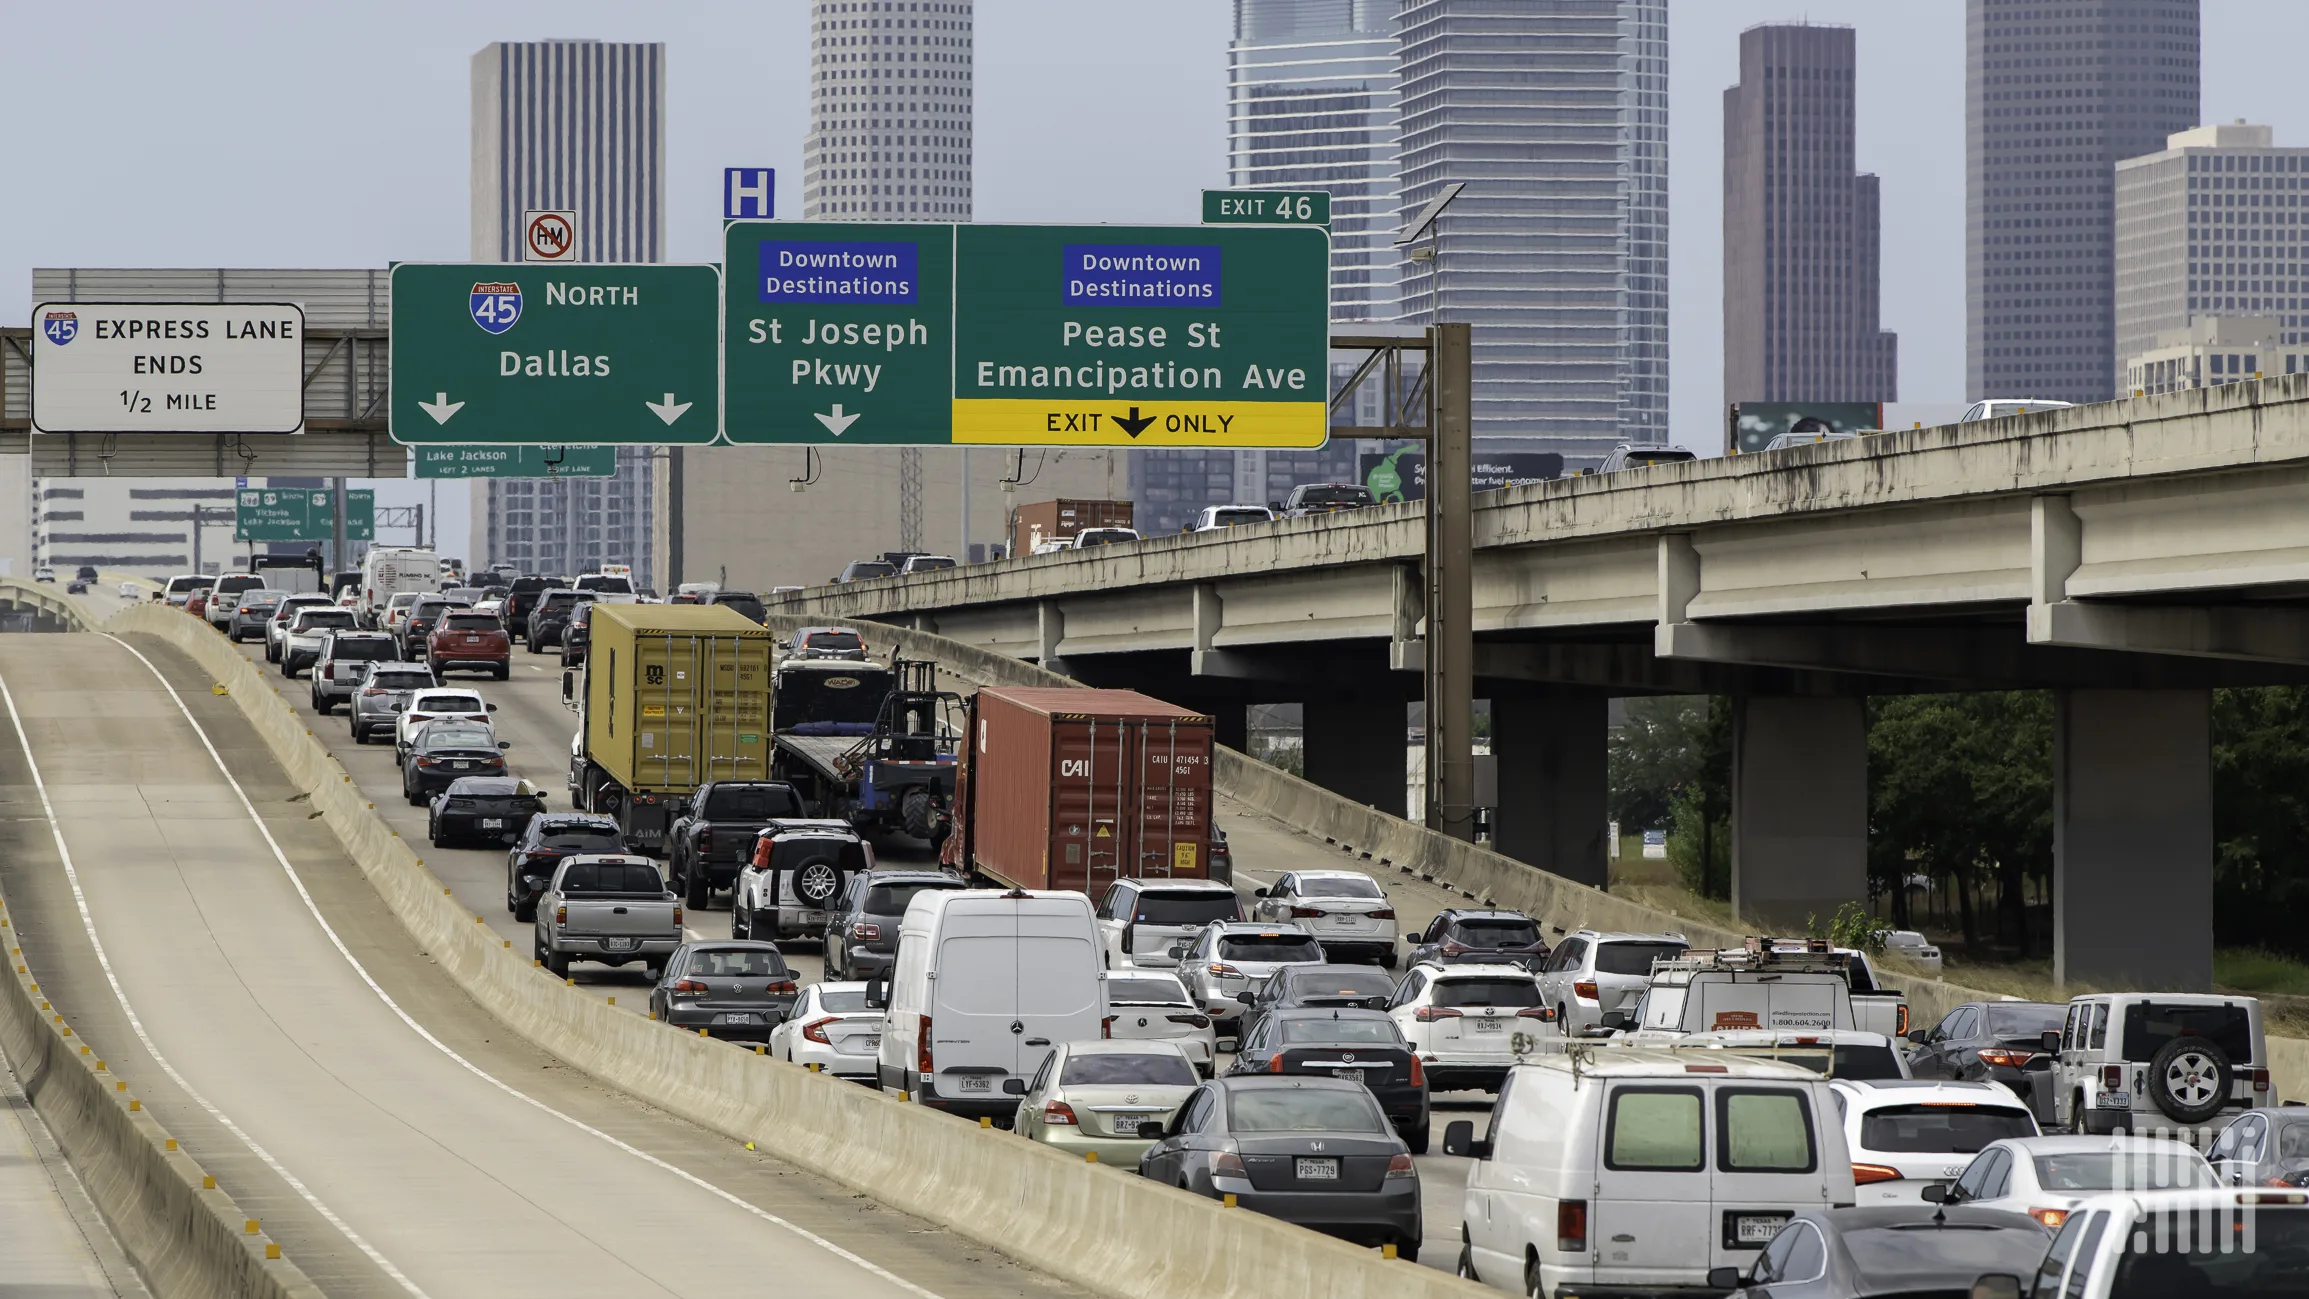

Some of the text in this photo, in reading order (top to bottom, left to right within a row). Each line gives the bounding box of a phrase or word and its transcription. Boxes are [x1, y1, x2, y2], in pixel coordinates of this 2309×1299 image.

[731, 171, 767, 216] H
[1220, 196, 1312, 221] EXIT 46
[779, 250, 898, 269] Downtown
[1082, 253, 1201, 272] Downtown
[766, 275, 910, 296] Destinations
[1069, 278, 1213, 298] Destinations
[475, 296, 517, 324] 45
[47, 323, 75, 340] 45
[96, 320, 293, 339] EXPRESS LANE
[748, 318, 928, 352] St Joseph
[1063, 321, 1221, 348] Pease St
[134, 355, 203, 374] ENDS
[500, 350, 611, 377] Dallas
[791, 359, 882, 393] Pkwy
[978, 360, 1307, 394] Emancipation Ave
[166, 394, 217, 410] MILE
[1047, 413, 1234, 434] EXIT ONLY
[426, 450, 507, 461] Lake Jackson
[461, 466, 468, 474] 2
[1488, 476, 1504, 485] fuel
[1061, 760, 1089, 776] CAI
[1152, 755, 1209, 765] CAIU 471454 3
[1772, 1019, 1831, 1027] 1.800.604.2600
